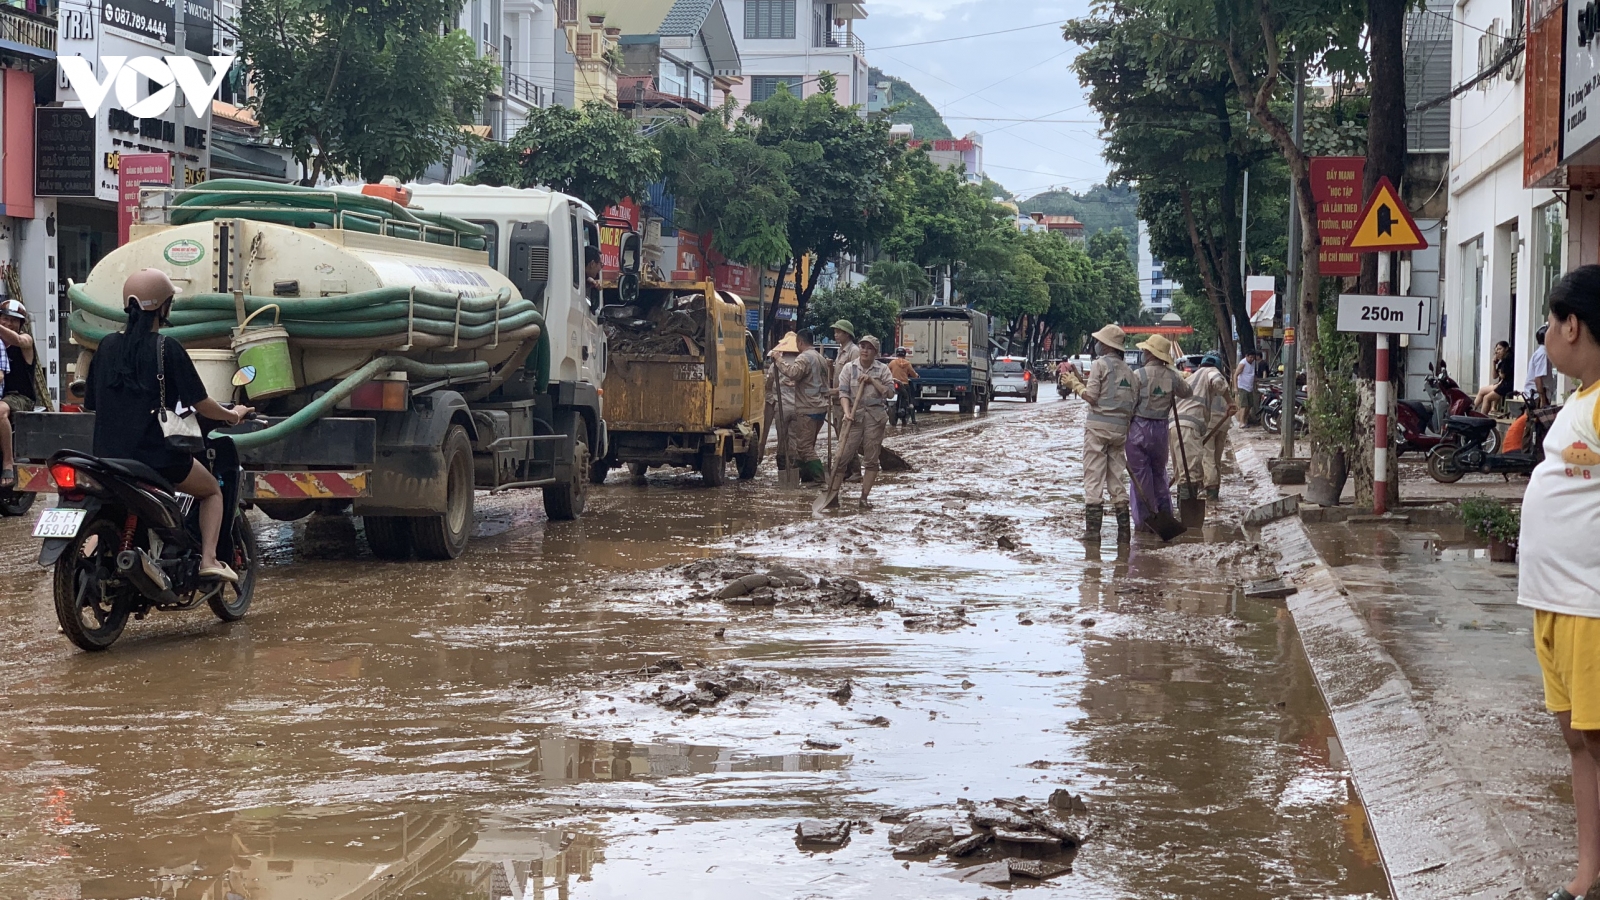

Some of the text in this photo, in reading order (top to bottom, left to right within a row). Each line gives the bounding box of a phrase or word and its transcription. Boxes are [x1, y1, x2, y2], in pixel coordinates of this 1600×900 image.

[187, 2, 212, 21] WATCH
[114, 7, 168, 37] 087.789.4444
[1344, 203, 1358, 213] THEO
[1322, 236, 1341, 246] PHONG
[1361, 306, 1404, 322] 250m
[45, 511, 78, 523] 26-F1
[37, 523, 77, 536] 159.03
